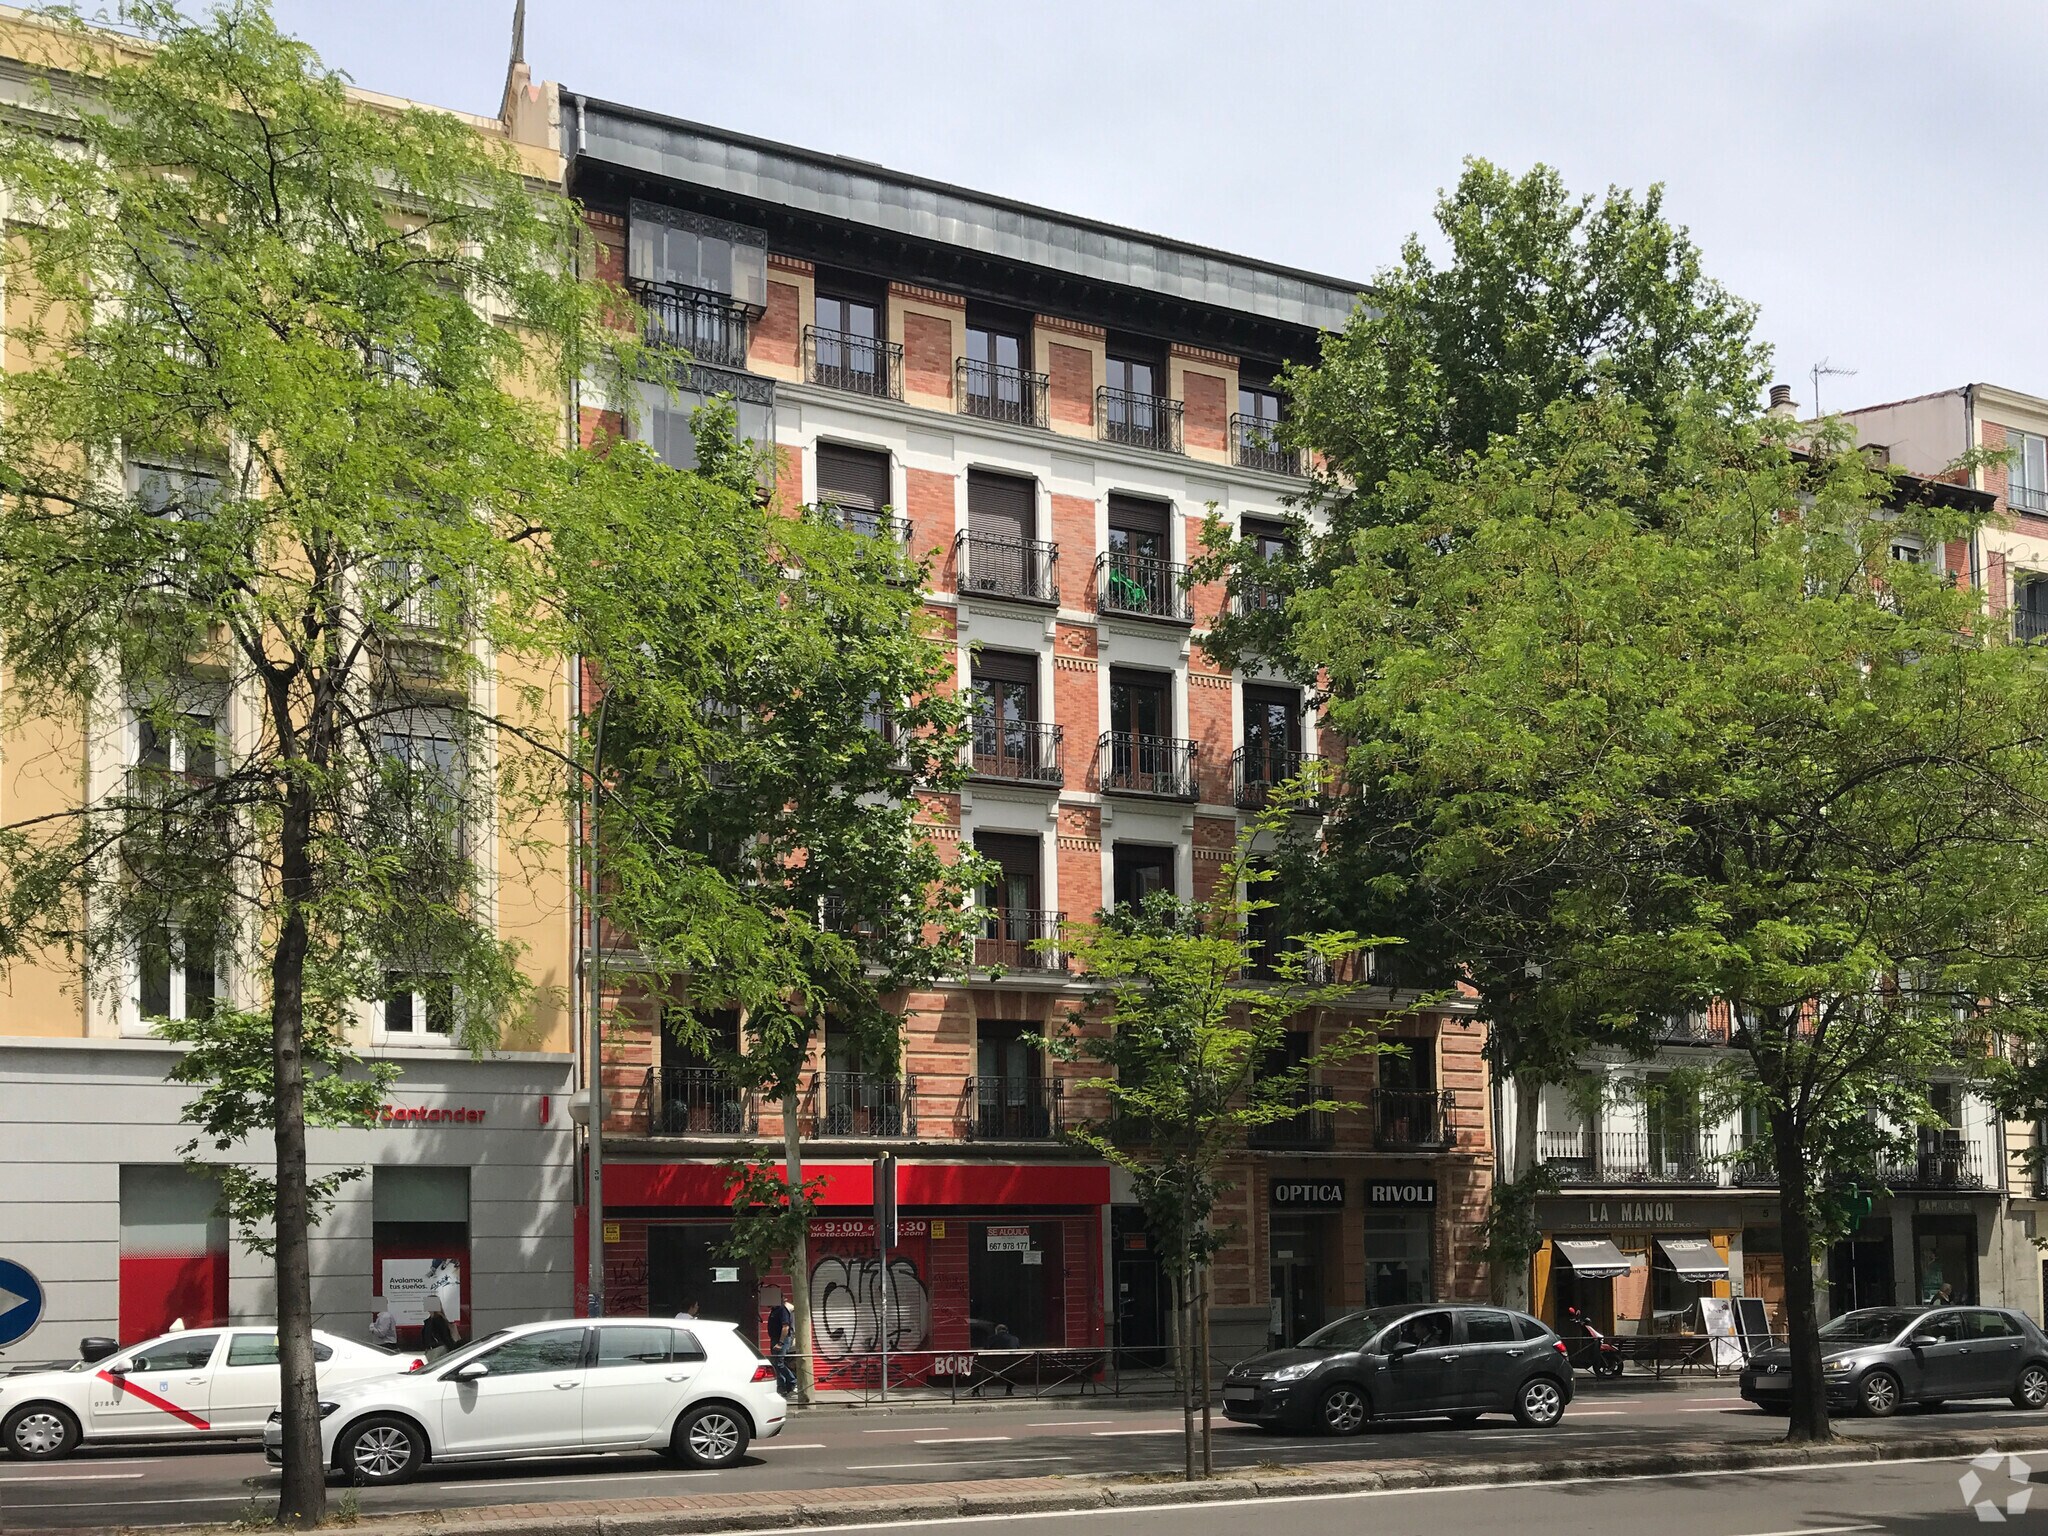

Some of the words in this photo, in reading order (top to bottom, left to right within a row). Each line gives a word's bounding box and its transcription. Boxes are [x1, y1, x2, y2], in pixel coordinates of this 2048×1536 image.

[382, 1104, 486, 1123] Santander
[1275, 1185, 1342, 1201] OPTICA
[1372, 1186, 1433, 1202] RIVOLI
[1589, 1203, 1609, 1222] LA
[1621, 1203, 1674, 1222] MANON
[825, 1221, 864, 1233] 9:00
[988, 1228, 998, 1236] SE
[1000, 1228, 1028, 1236] ALQUILA
[989, 1242, 1001, 1250] 667
[1002, 1242, 1015, 1250] 978
